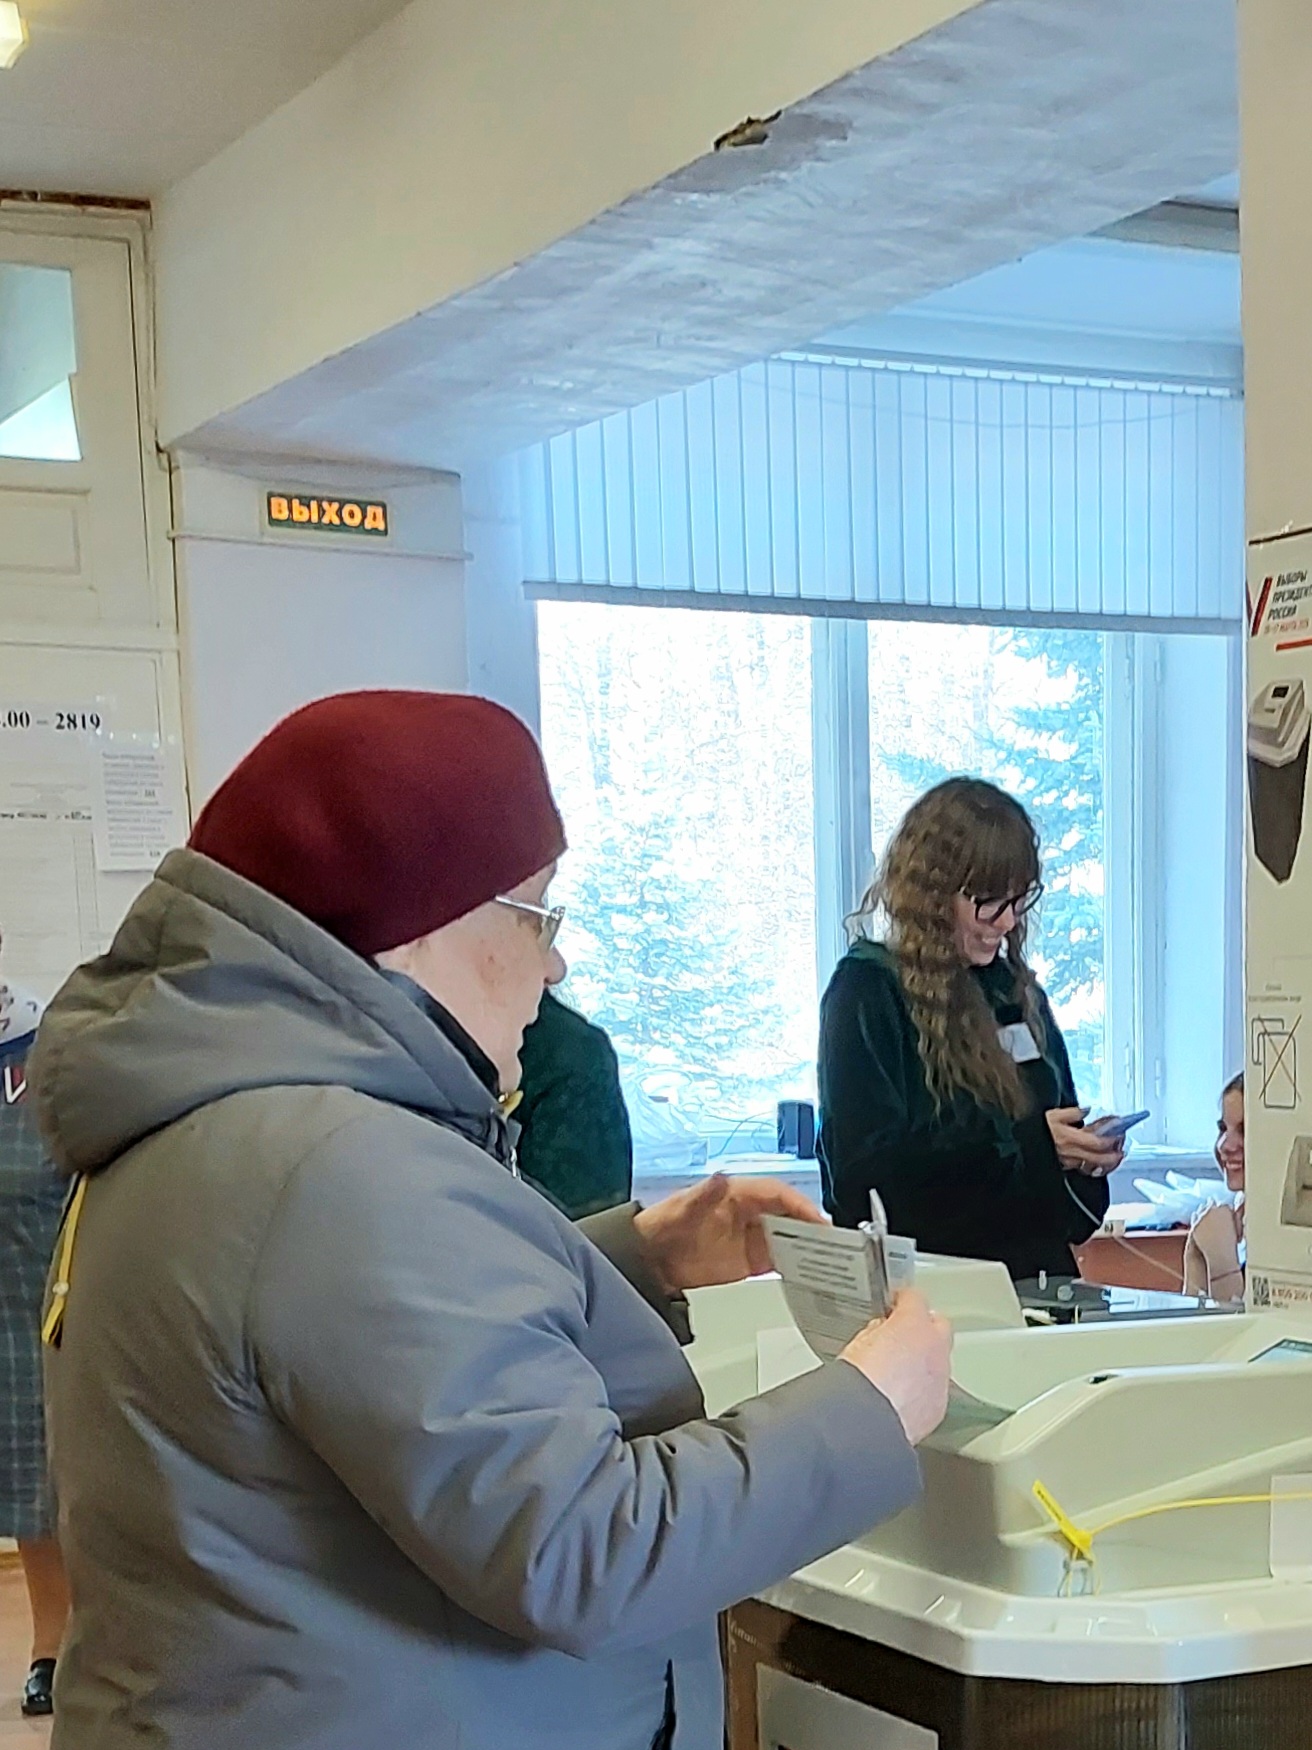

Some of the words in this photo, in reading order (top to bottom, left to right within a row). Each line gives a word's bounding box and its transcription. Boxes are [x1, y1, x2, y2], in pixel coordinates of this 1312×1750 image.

[270, 496, 386, 531] ВЫХОД
[0, 711, 30, 728] .00
[56, 712, 100, 730] 2819
